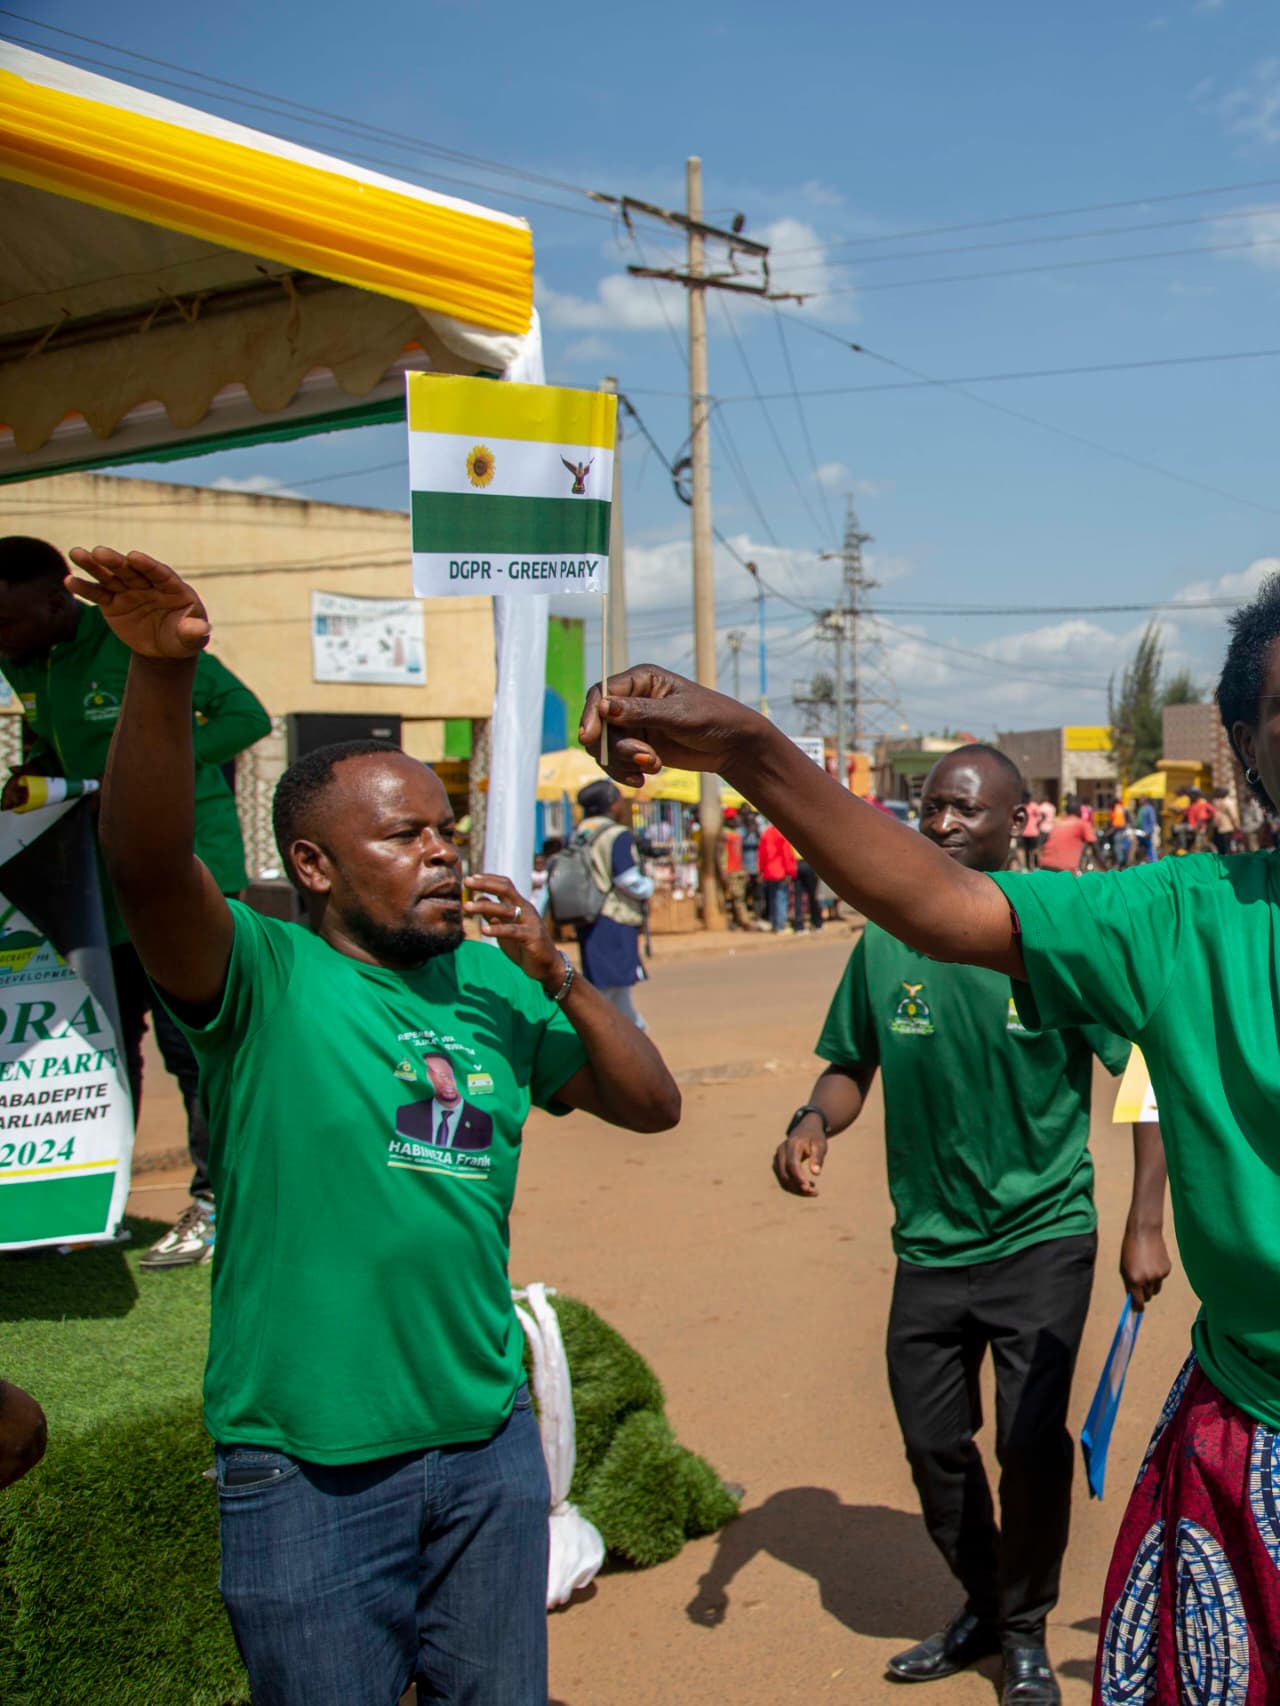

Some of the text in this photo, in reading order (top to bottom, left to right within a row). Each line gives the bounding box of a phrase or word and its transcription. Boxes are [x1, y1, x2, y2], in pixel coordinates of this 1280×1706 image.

[450, 561, 492, 579] DGPR
[508, 561, 557, 580] GREEN
[0, 1136, 75, 1168] 2024
[456, 1153, 491, 1168] Frank
